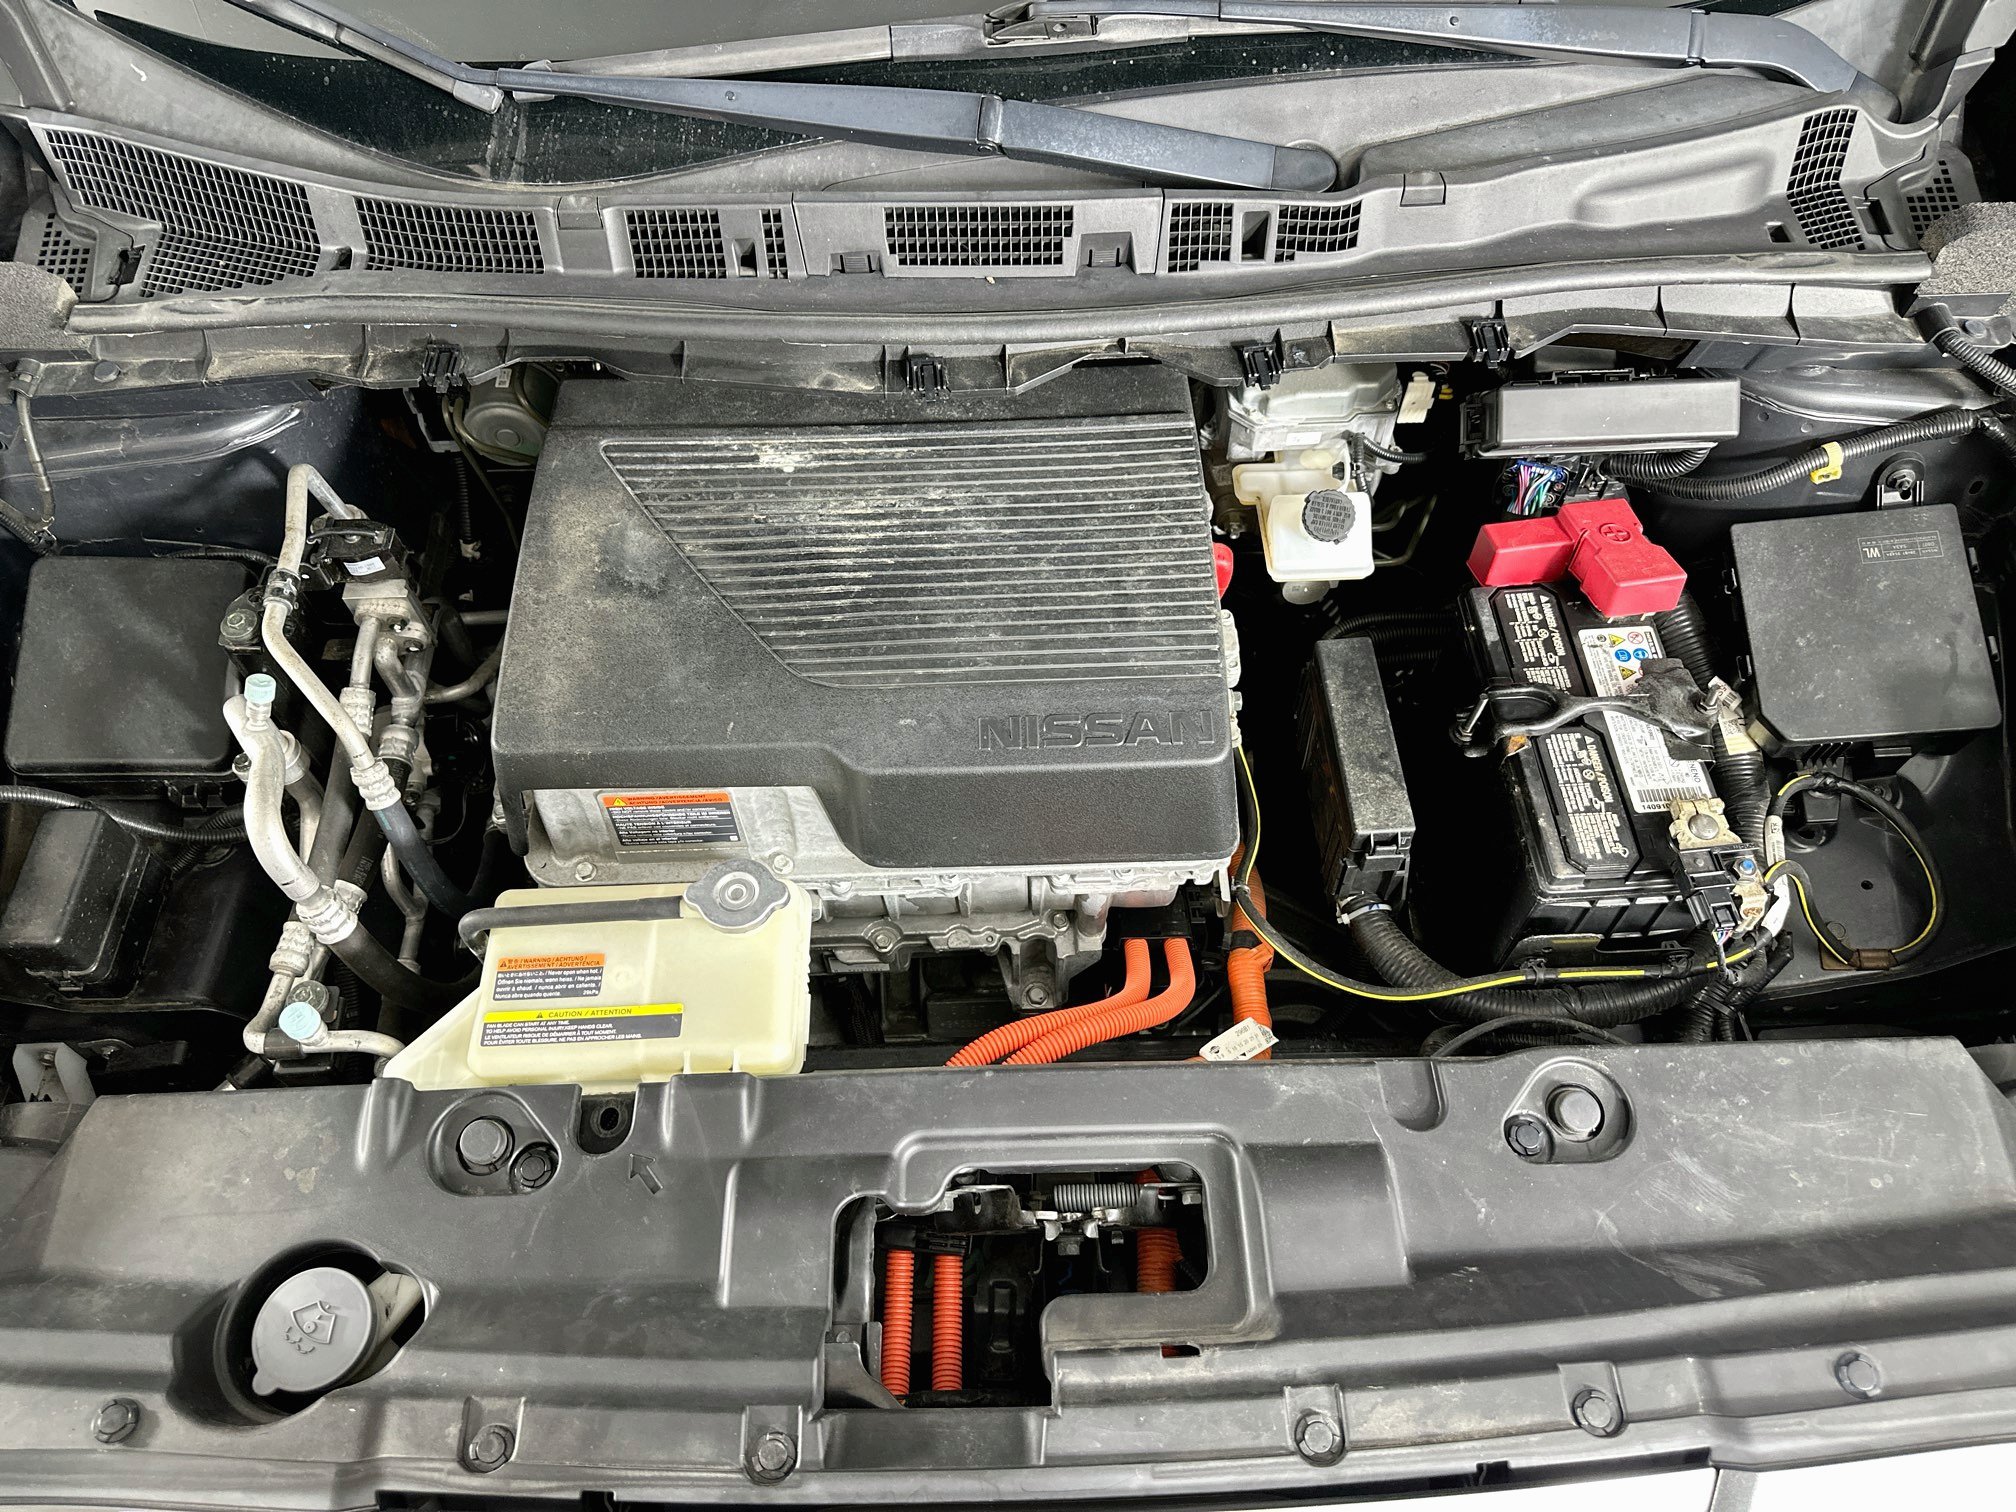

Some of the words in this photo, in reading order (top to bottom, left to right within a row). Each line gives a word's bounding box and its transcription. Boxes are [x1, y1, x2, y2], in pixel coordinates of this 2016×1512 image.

[1862, 547, 1881, 558] WL
[978, 710, 1214, 750] NISSAN
[548, 1010, 582, 1018] CAUTION
[591, 1008, 632, 1016] ATTENTION
